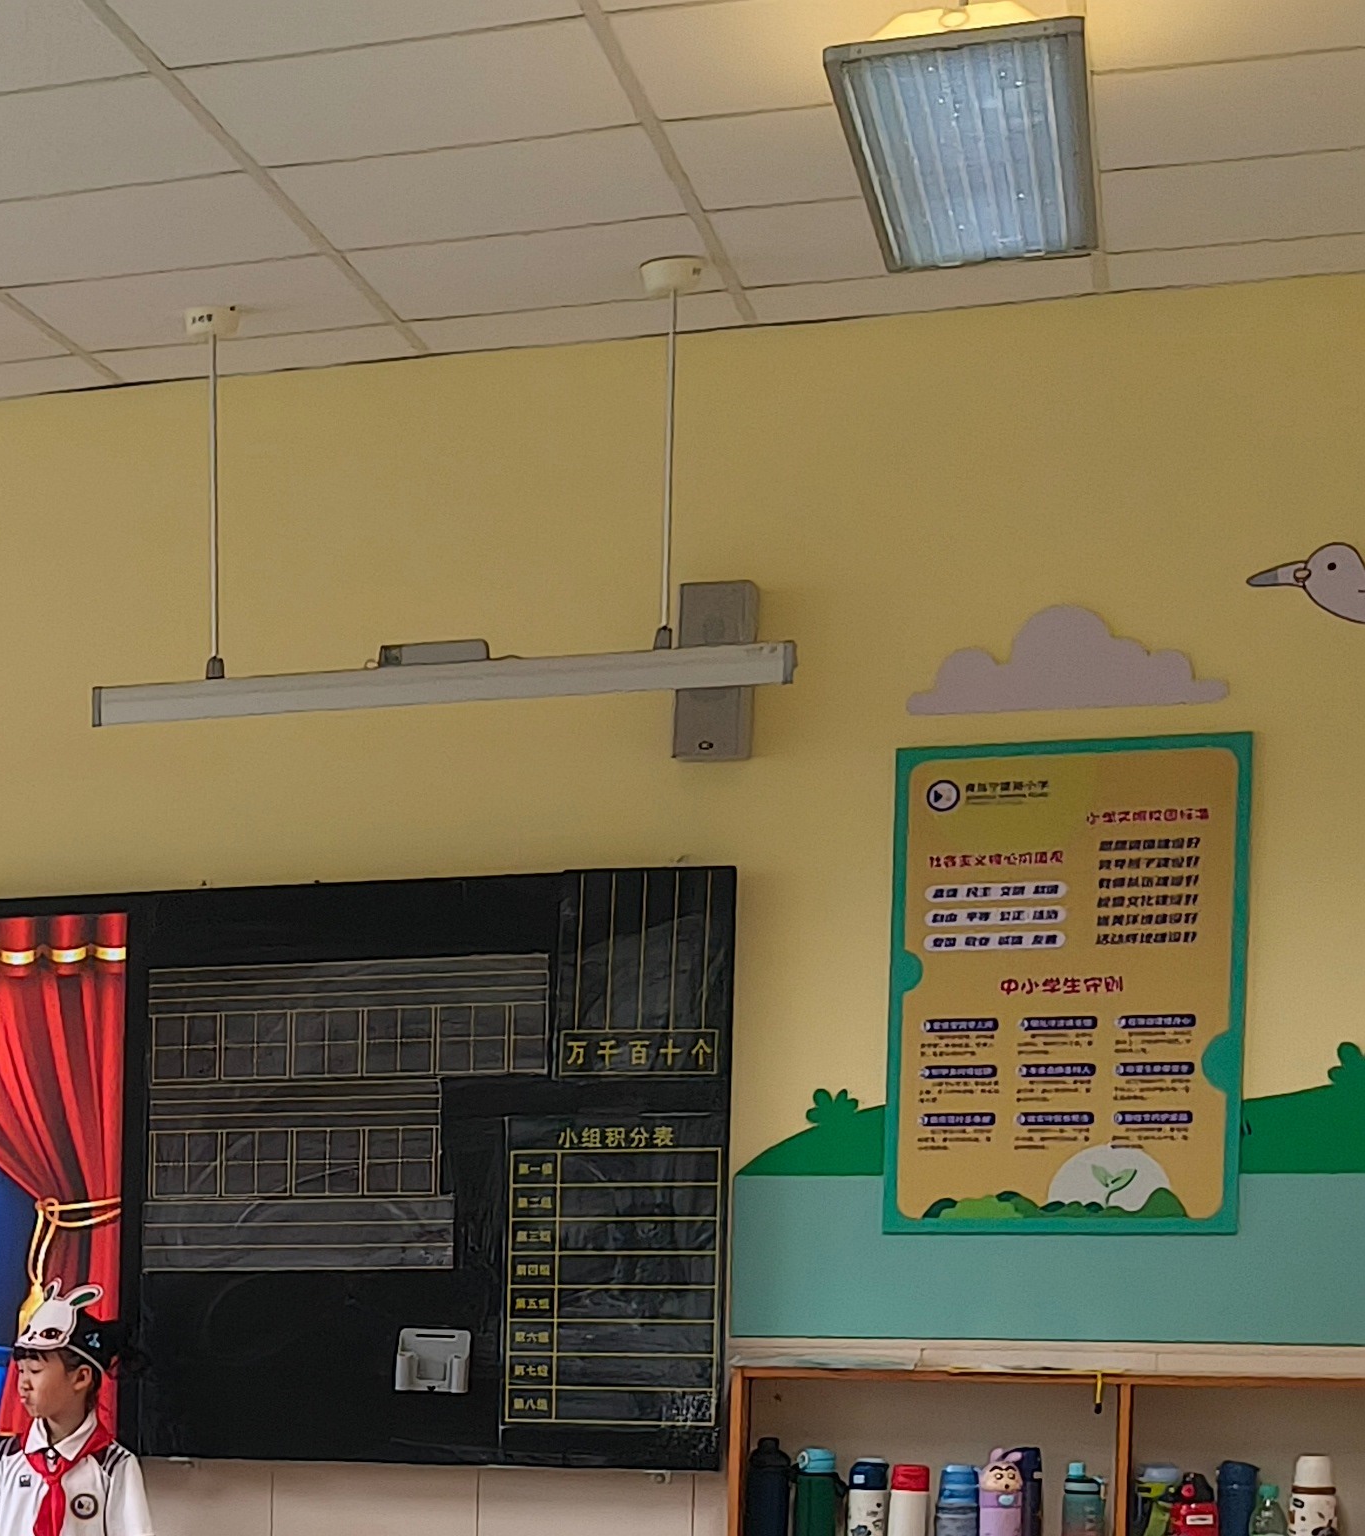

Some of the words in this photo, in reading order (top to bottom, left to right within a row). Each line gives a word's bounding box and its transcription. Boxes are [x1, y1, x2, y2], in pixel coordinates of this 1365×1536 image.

[1000, 976, 1124, 995] 中小学生守则
[558, 1126, 674, 1149] 小组积分表
